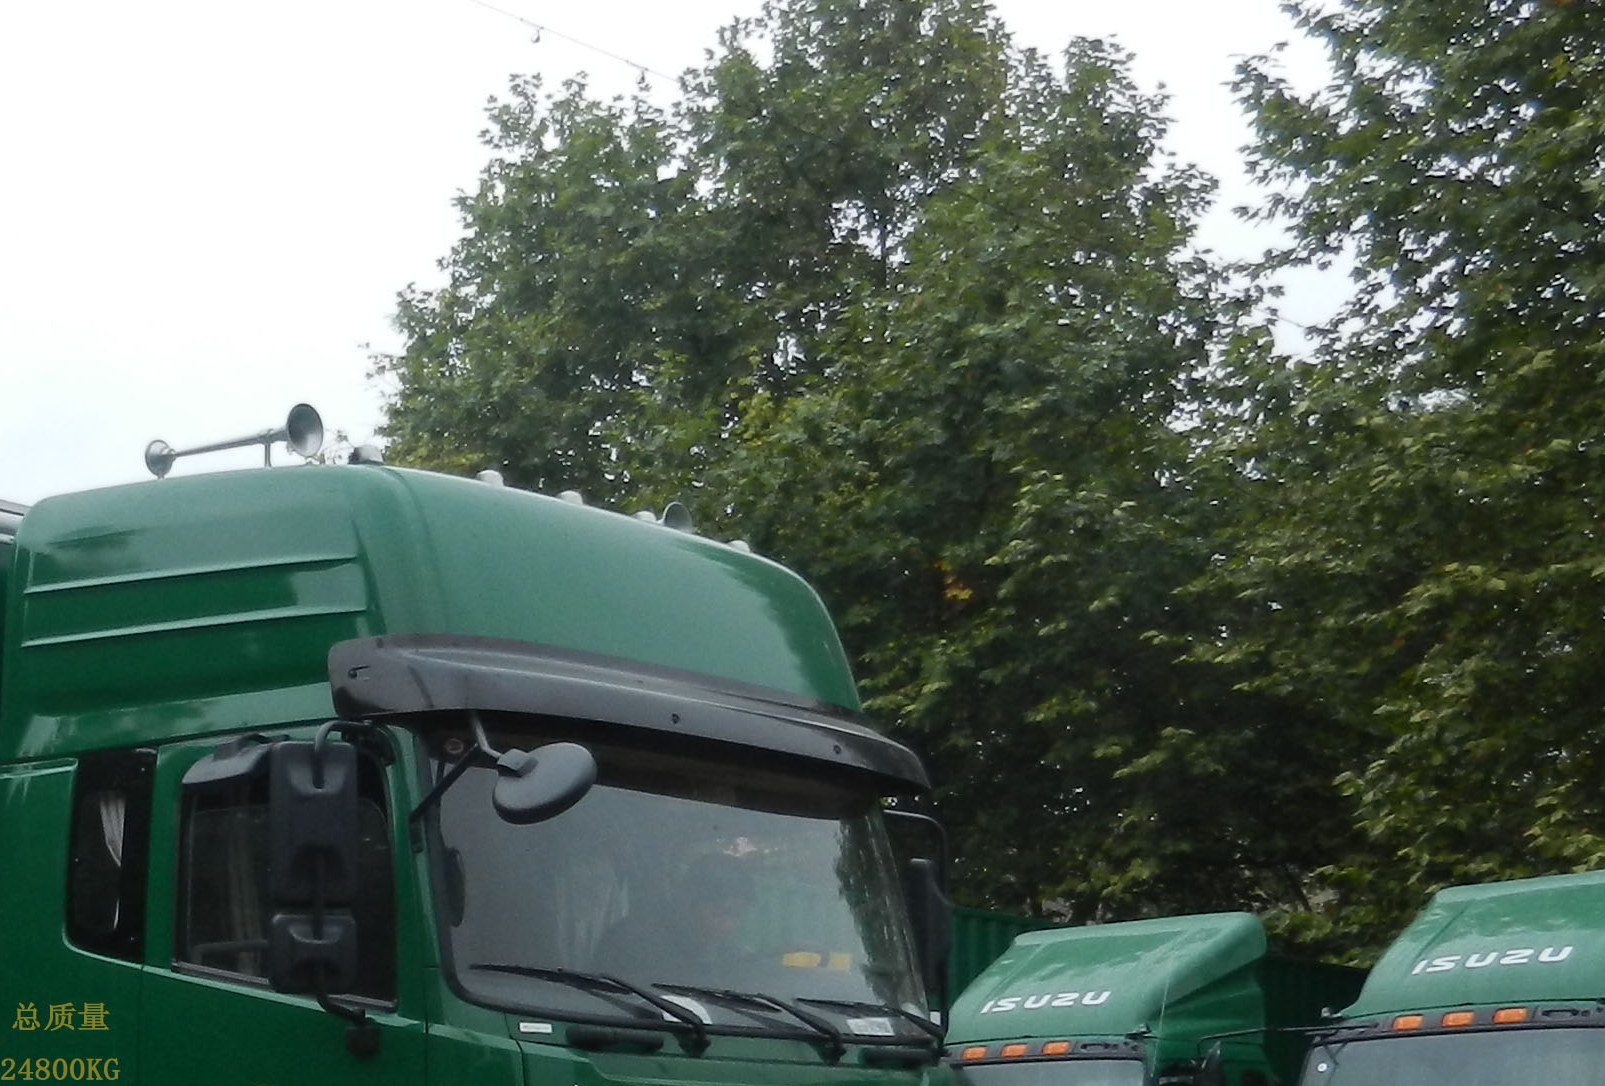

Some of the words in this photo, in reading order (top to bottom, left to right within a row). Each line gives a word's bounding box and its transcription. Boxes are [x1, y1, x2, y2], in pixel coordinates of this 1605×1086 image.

[1411, 946, 1573, 975] ISUZU
[979, 990, 1111, 1014] ISUZU
[12, 1002, 111, 1031] 总质量
[0, 1057, 122, 1081] 24800KG
